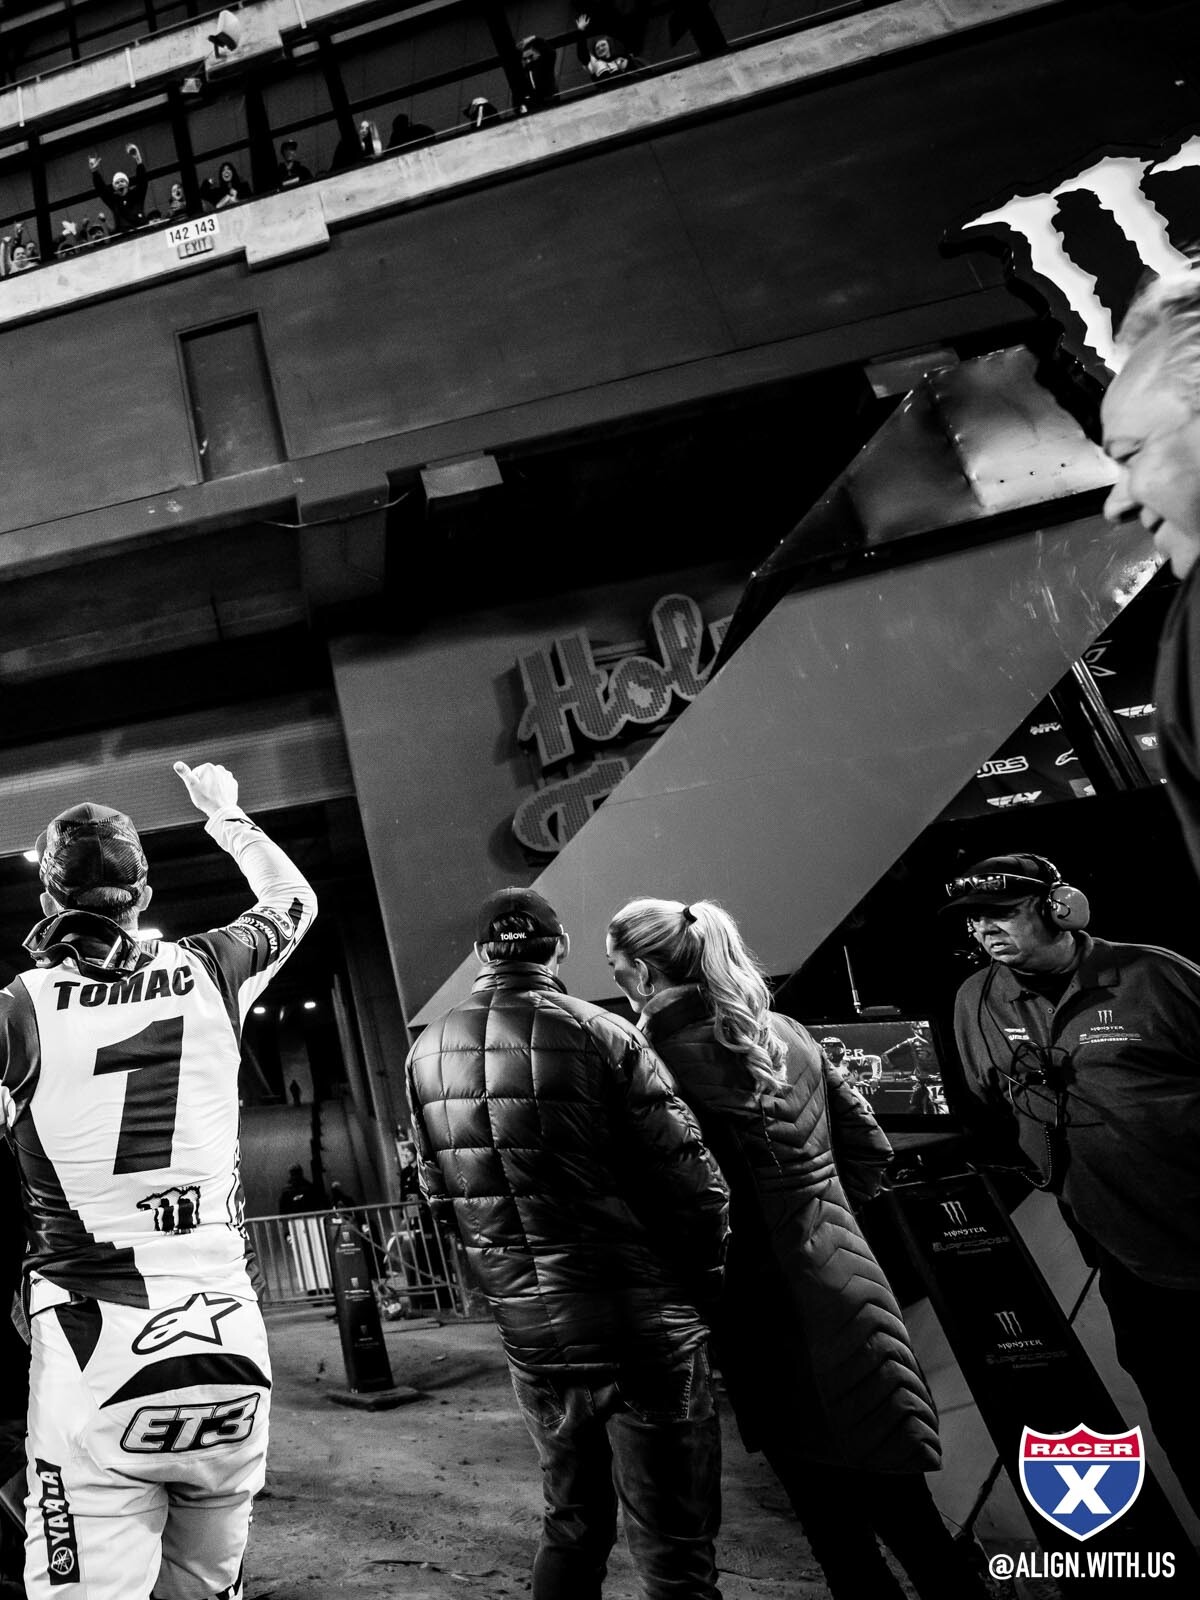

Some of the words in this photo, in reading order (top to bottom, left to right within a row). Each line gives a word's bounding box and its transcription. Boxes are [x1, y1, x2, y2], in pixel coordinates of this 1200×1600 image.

[170, 227, 189, 243] 142
[195, 219, 215, 235] 143
[517, 594, 734, 767] Hol
[500, 932, 527, 941] follow.
[54, 965, 194, 1010] TOMAC
[93, 1016, 184, 1175] 1
[944, 1226, 987, 1238] MONSTER
[997, 1339, 1043, 1350] MONSTER
[120, 1393, 260, 1453] ET3
